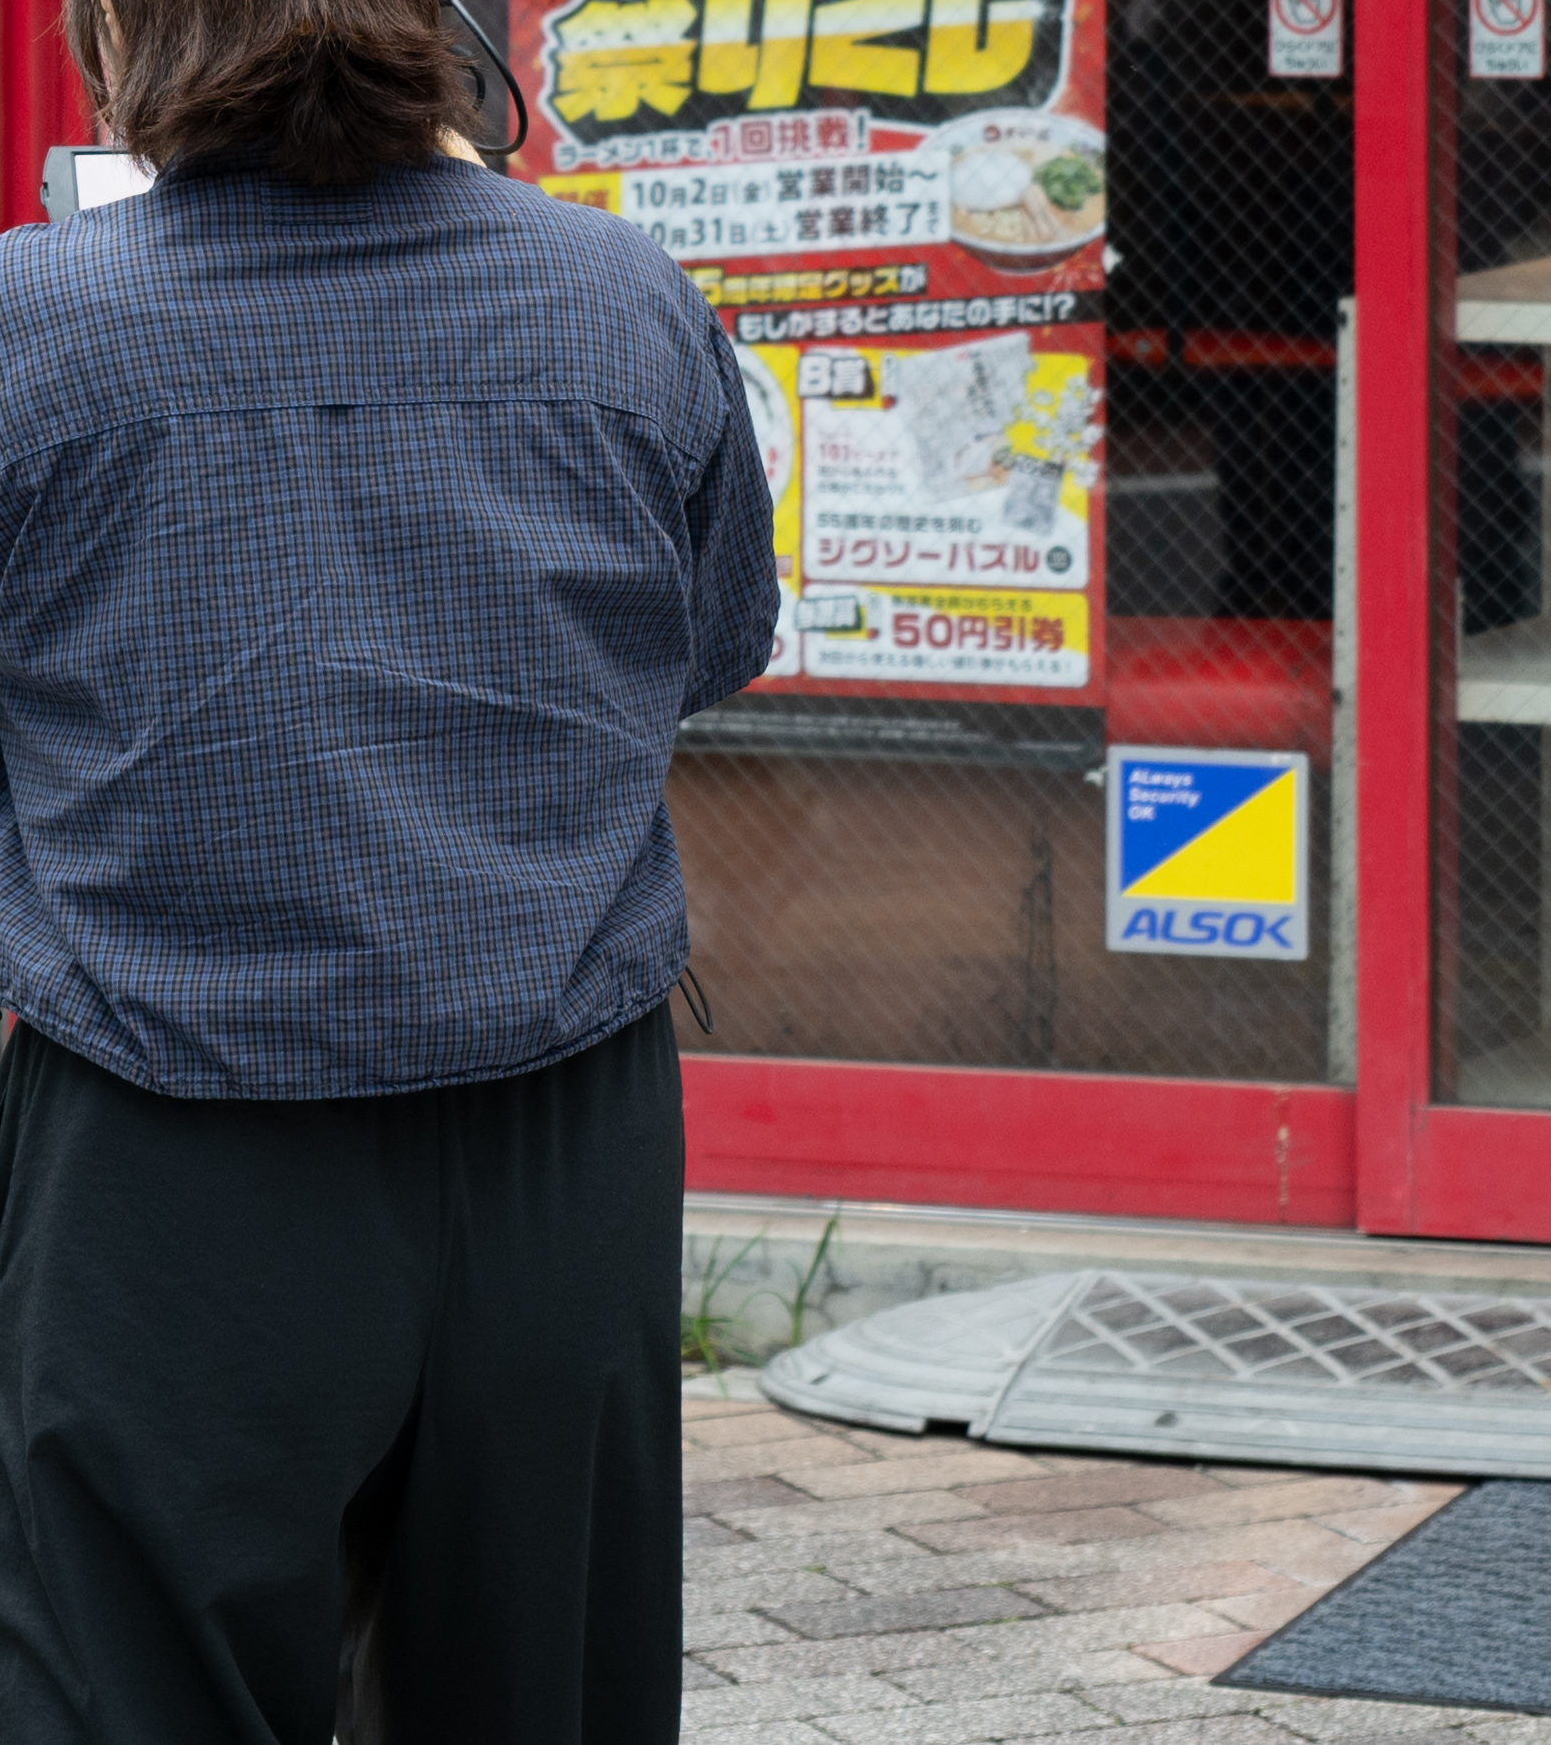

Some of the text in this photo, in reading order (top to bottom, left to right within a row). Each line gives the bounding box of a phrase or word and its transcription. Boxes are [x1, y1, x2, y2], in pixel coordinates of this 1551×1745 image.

[893, 612, 1064, 653] 50円引券
[1127, 805, 1157, 821] OK
[1128, 787, 1201, 809] Security
[1121, 907, 1294, 950] ALSOK
